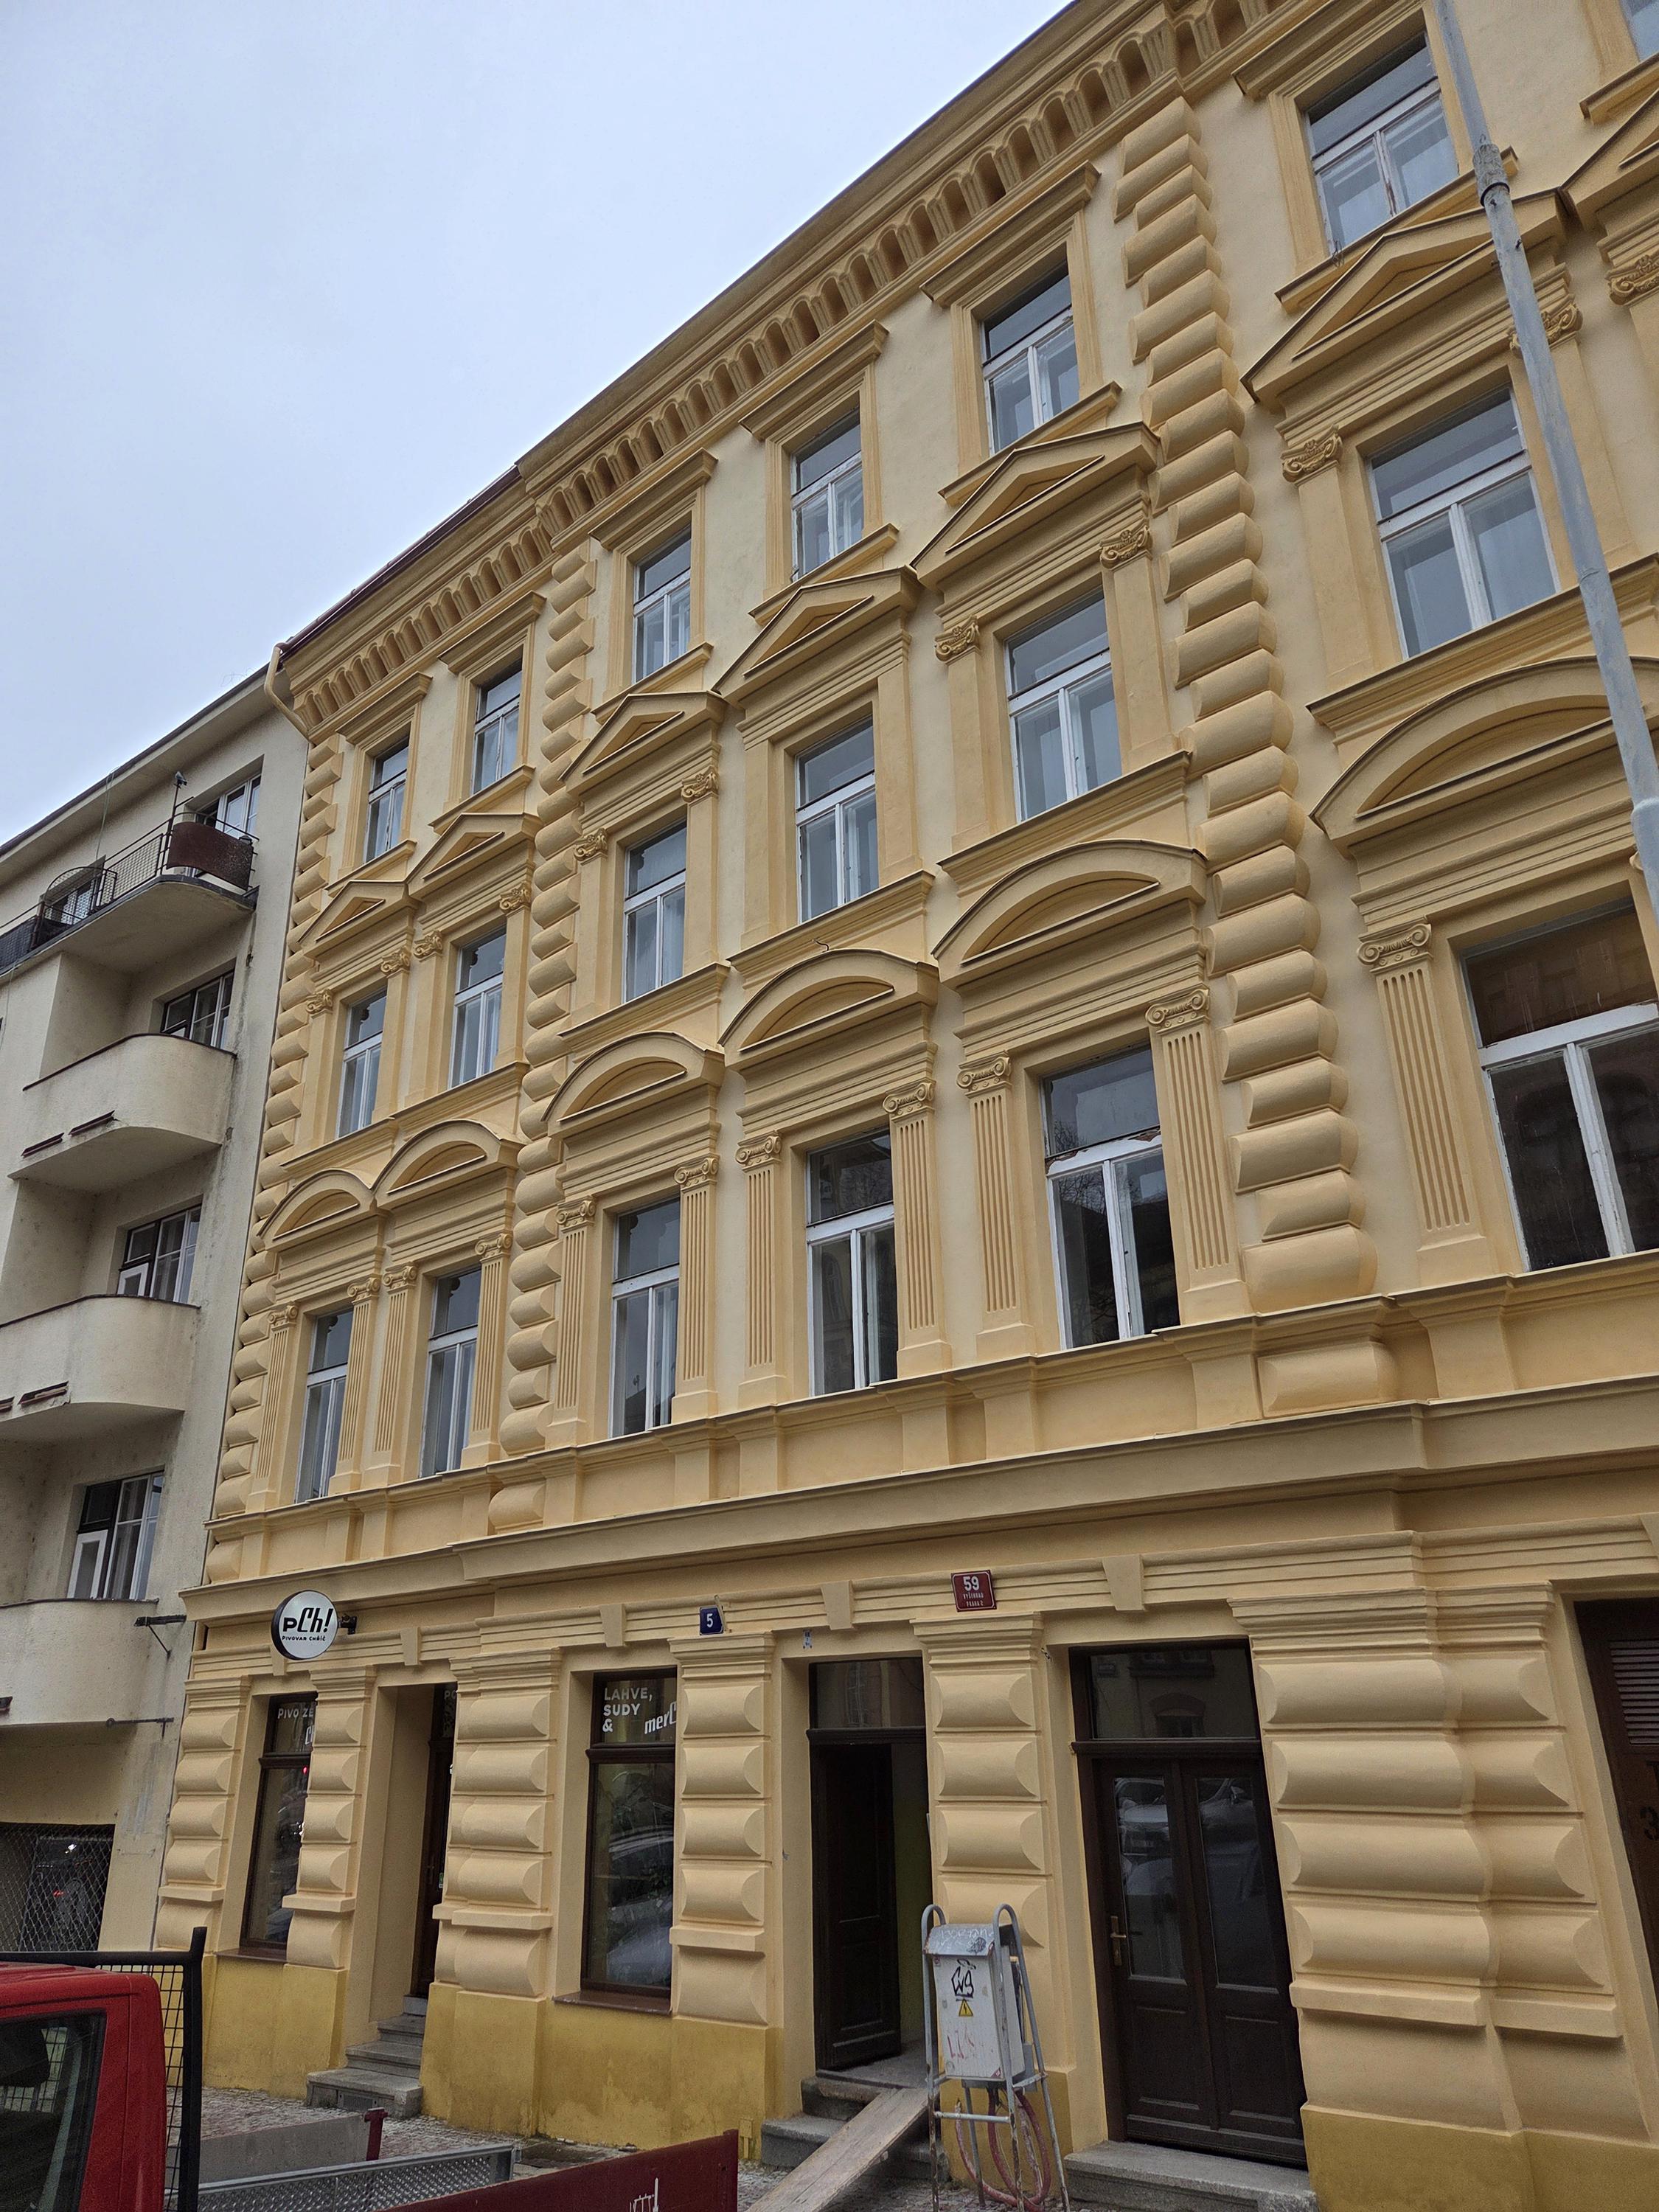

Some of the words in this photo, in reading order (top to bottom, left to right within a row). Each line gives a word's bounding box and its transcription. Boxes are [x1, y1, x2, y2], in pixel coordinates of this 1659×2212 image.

[963, 1576, 980, 1591] 59
[706, 1613, 714, 1628] 5
[604, 1687, 653, 1701] LAHVE,
[277, 1708, 299, 1719] PIVO
[603, 1703, 641, 1717] SUDY
[602, 1718, 613, 1733] &
